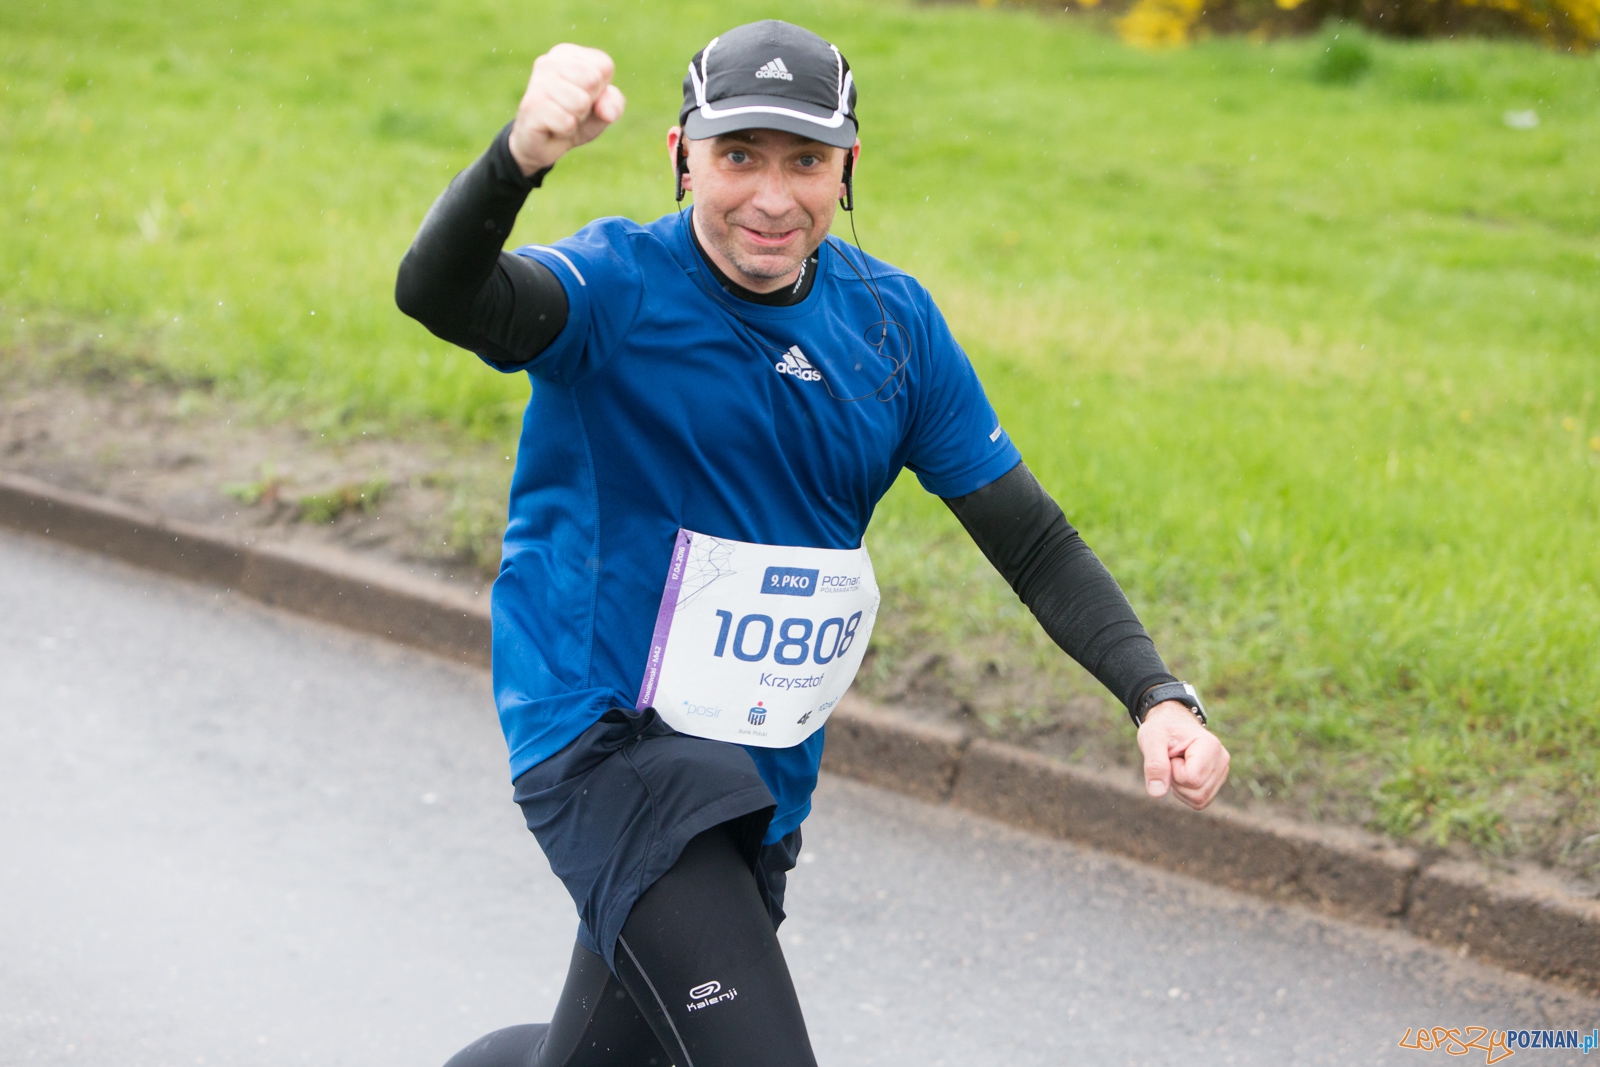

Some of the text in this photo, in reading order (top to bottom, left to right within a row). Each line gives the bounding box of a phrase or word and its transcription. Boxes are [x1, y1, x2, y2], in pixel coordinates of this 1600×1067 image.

[755, 70, 793, 81] adidas
[775, 362, 821, 381] addas
[672, 546, 686, 580] 17.04.2016
[713, 609, 863, 666] 10808
[642, 668, 657, 705] Kowalewski
[652, 645, 662, 663] M42
[759, 672, 825, 691] Krzysztof
